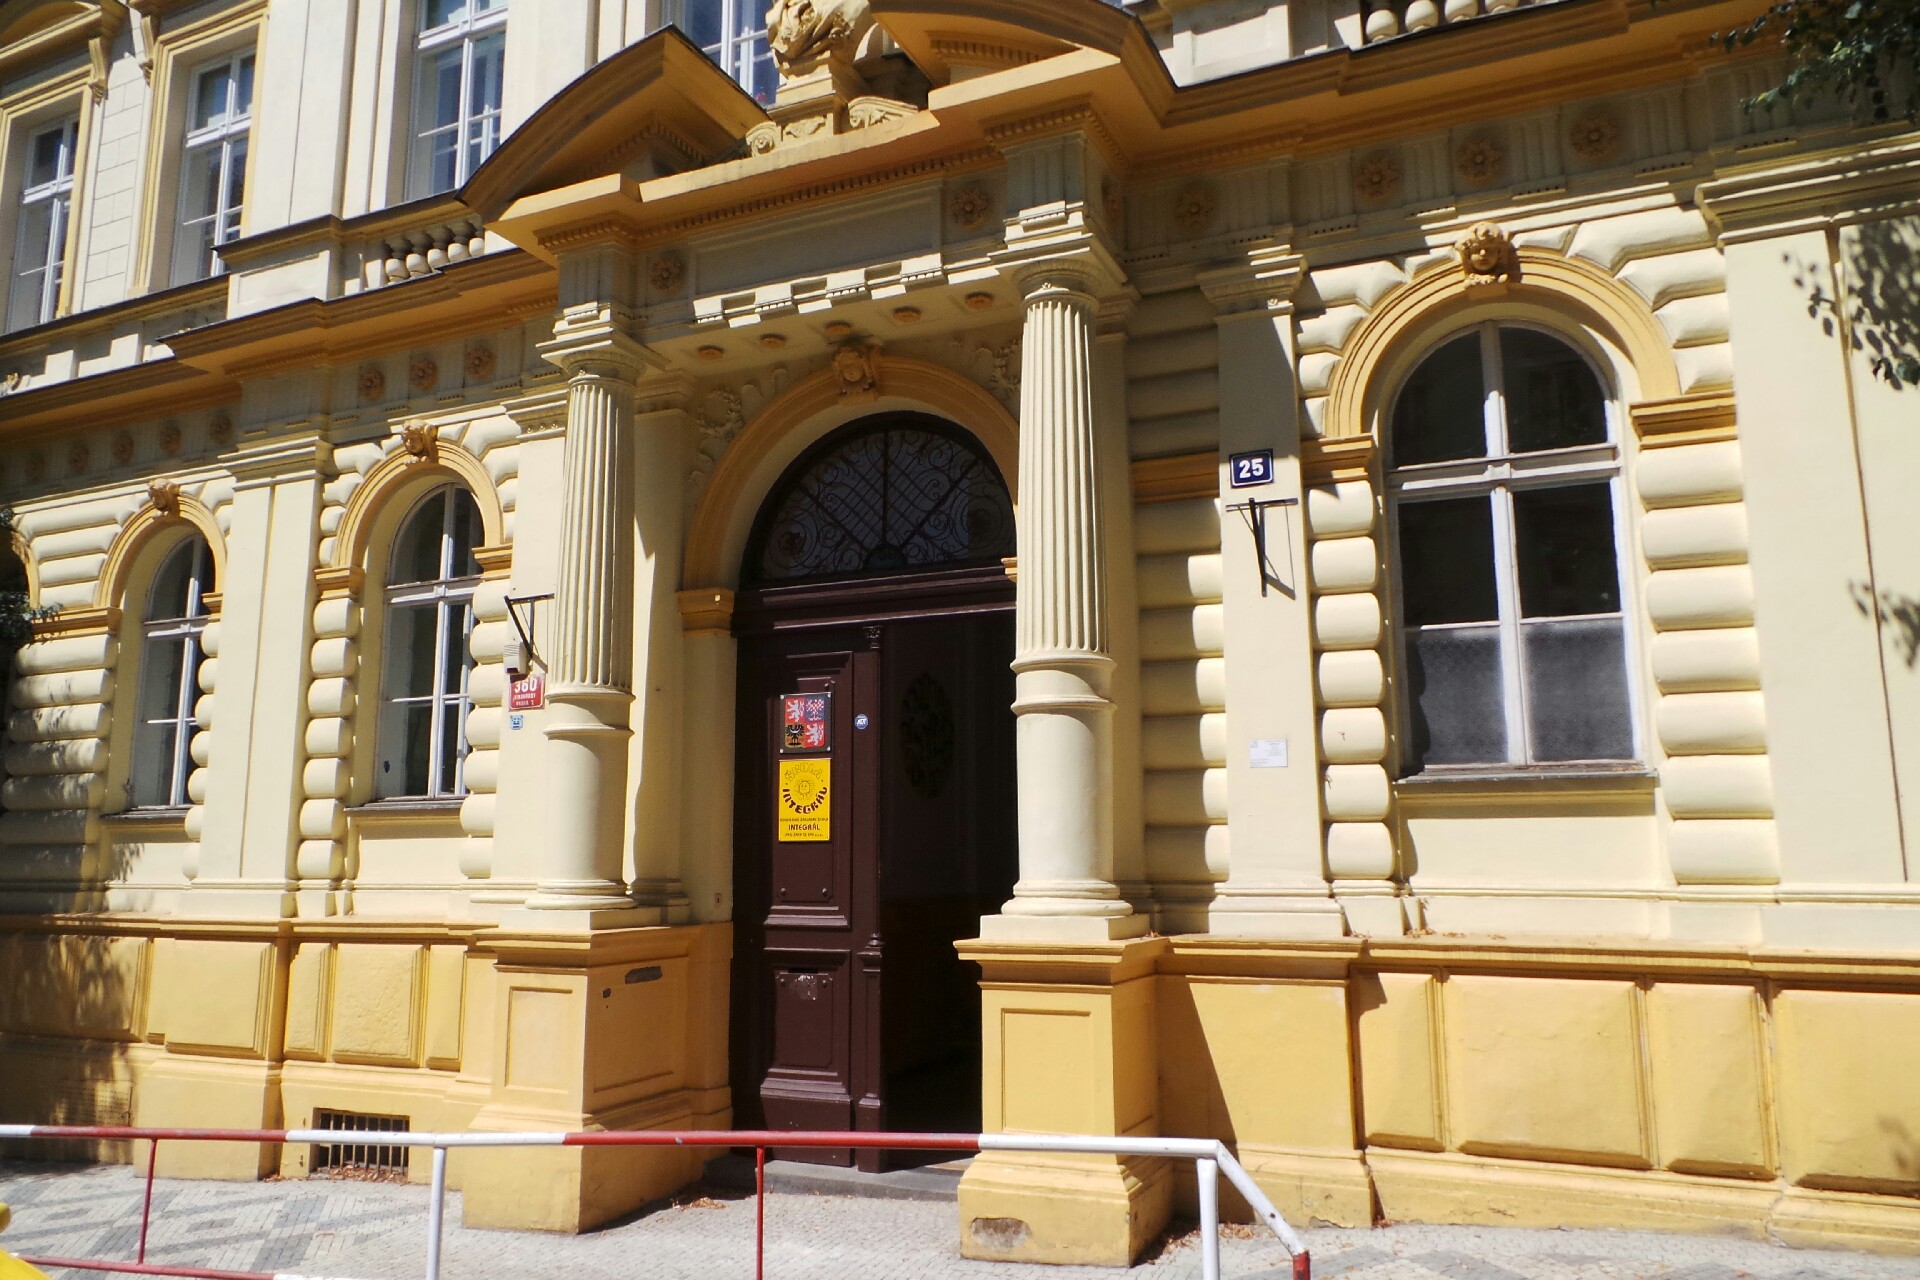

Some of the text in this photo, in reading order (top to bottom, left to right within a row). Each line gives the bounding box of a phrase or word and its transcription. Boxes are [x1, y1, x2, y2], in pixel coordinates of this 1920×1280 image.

[1239, 457, 1264, 479] 25
[514, 676, 538, 693] 360
[782, 786, 828, 814] INTEGRÁL
[788, 822, 821, 831] INTEGRÁL
